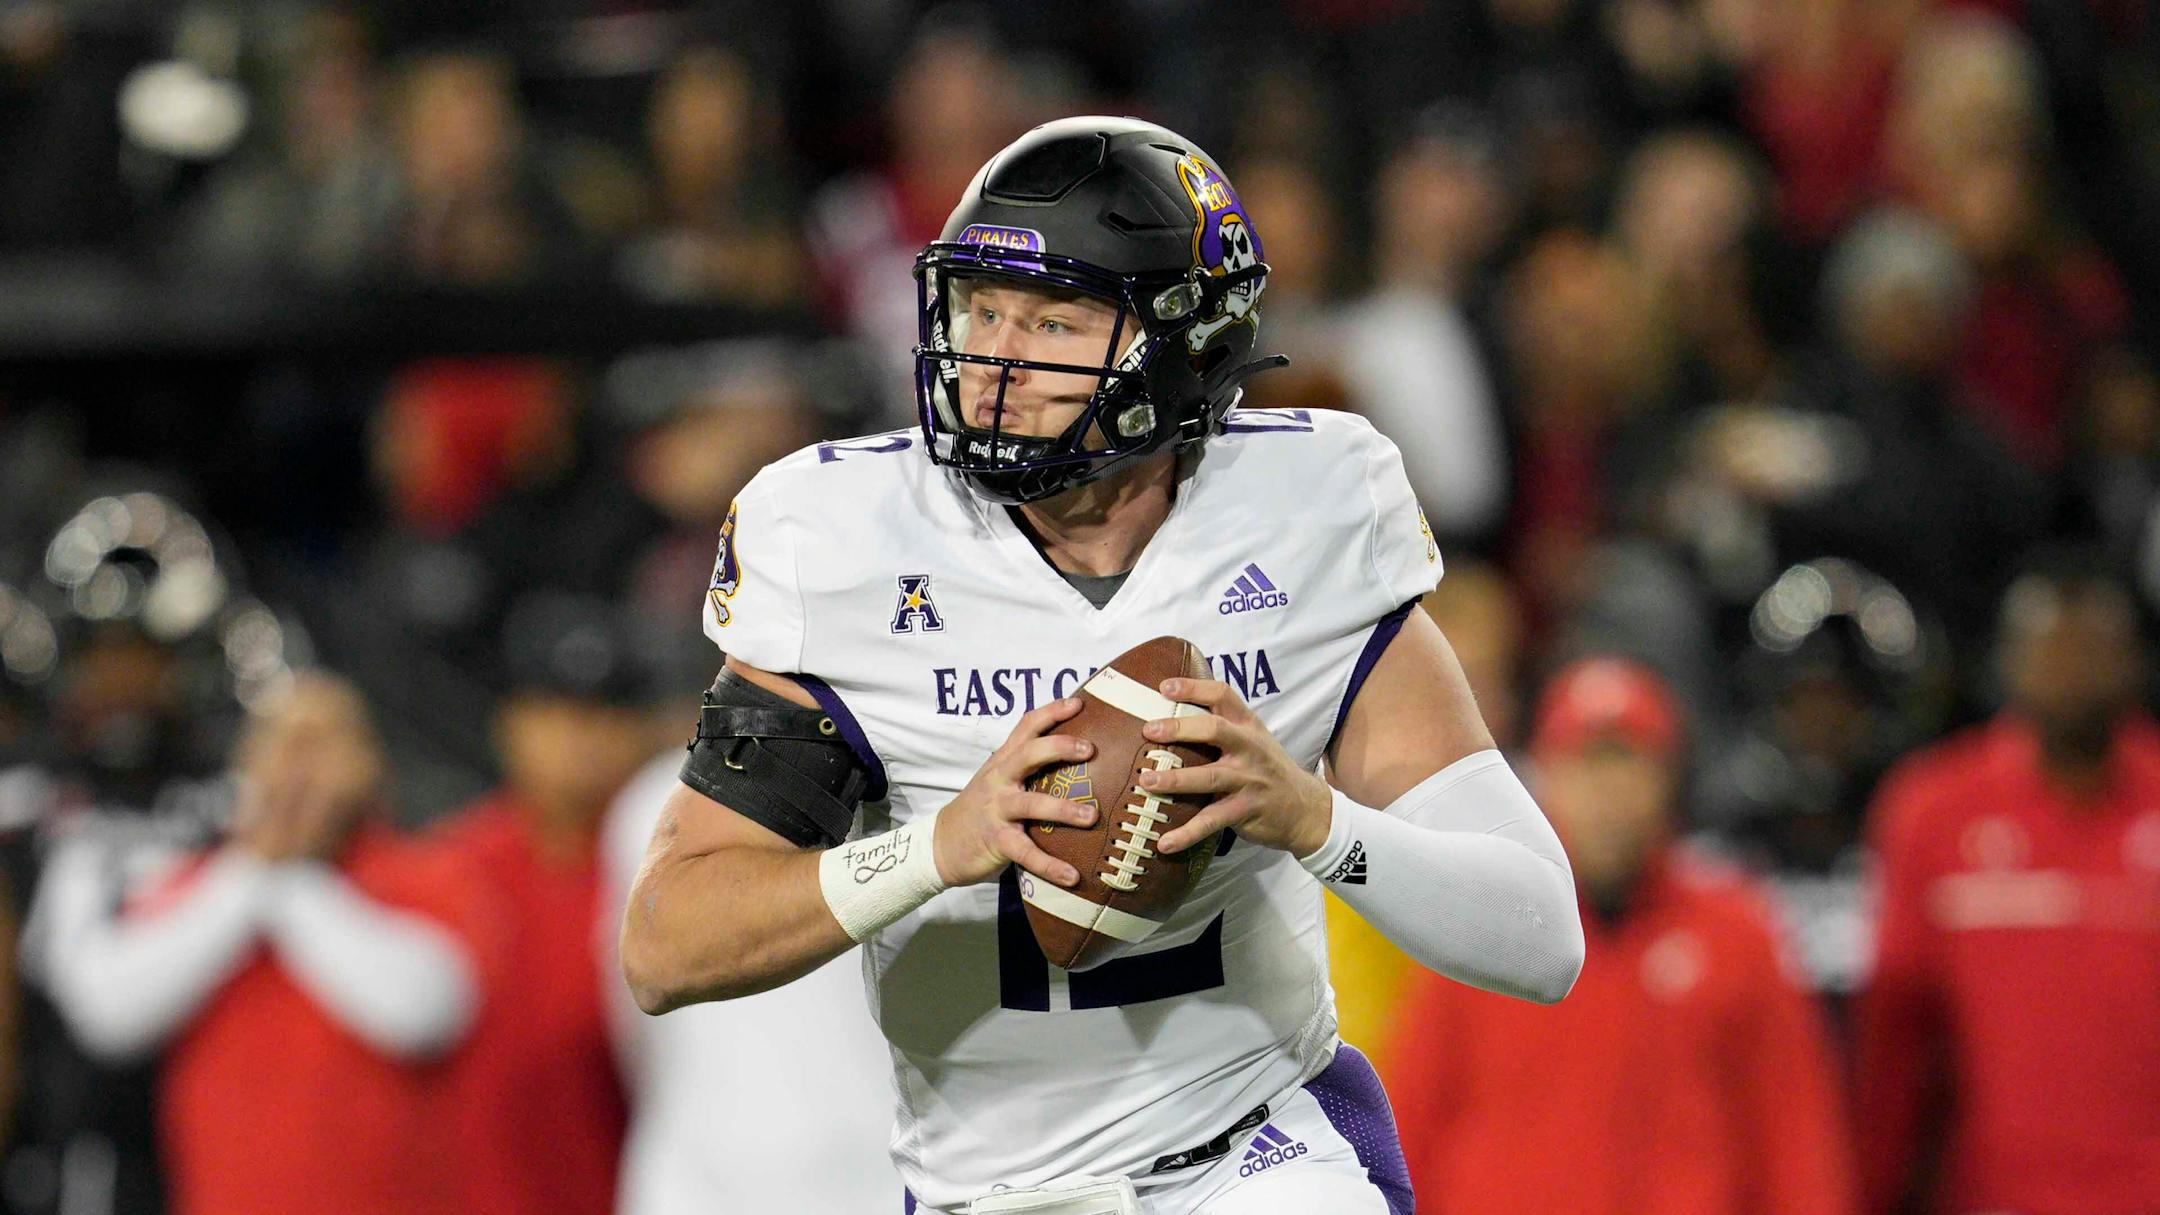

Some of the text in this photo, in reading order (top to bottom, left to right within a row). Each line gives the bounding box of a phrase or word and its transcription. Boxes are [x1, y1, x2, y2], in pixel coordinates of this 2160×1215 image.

[966, 228, 1030, 249] PIRATES
[1219, 591, 1288, 615] adidas
[933, 668, 1041, 716] EAST
[843, 828, 912, 869] family
[1325, 840, 1363, 883] adidas
[1239, 1141, 1308, 1178] adidas
